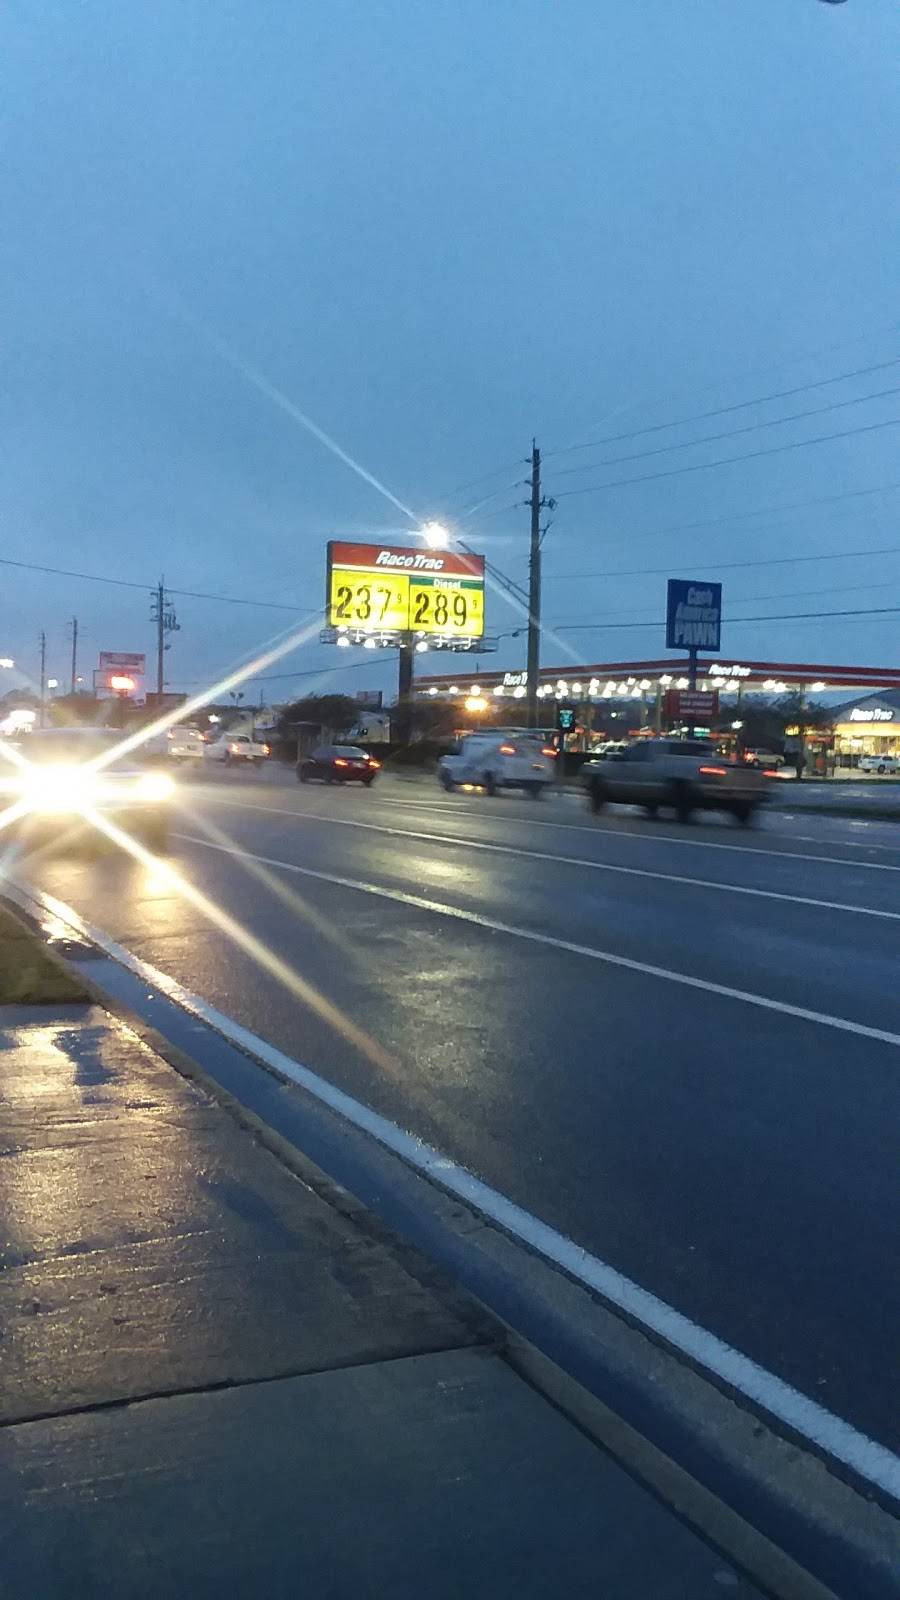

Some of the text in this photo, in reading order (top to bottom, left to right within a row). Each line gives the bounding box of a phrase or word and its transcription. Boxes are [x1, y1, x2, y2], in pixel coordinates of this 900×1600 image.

[376, 551, 444, 569] RaceTrac
[433, 578, 461, 589] Diesel
[674, 619, 718, 646] PAWN
